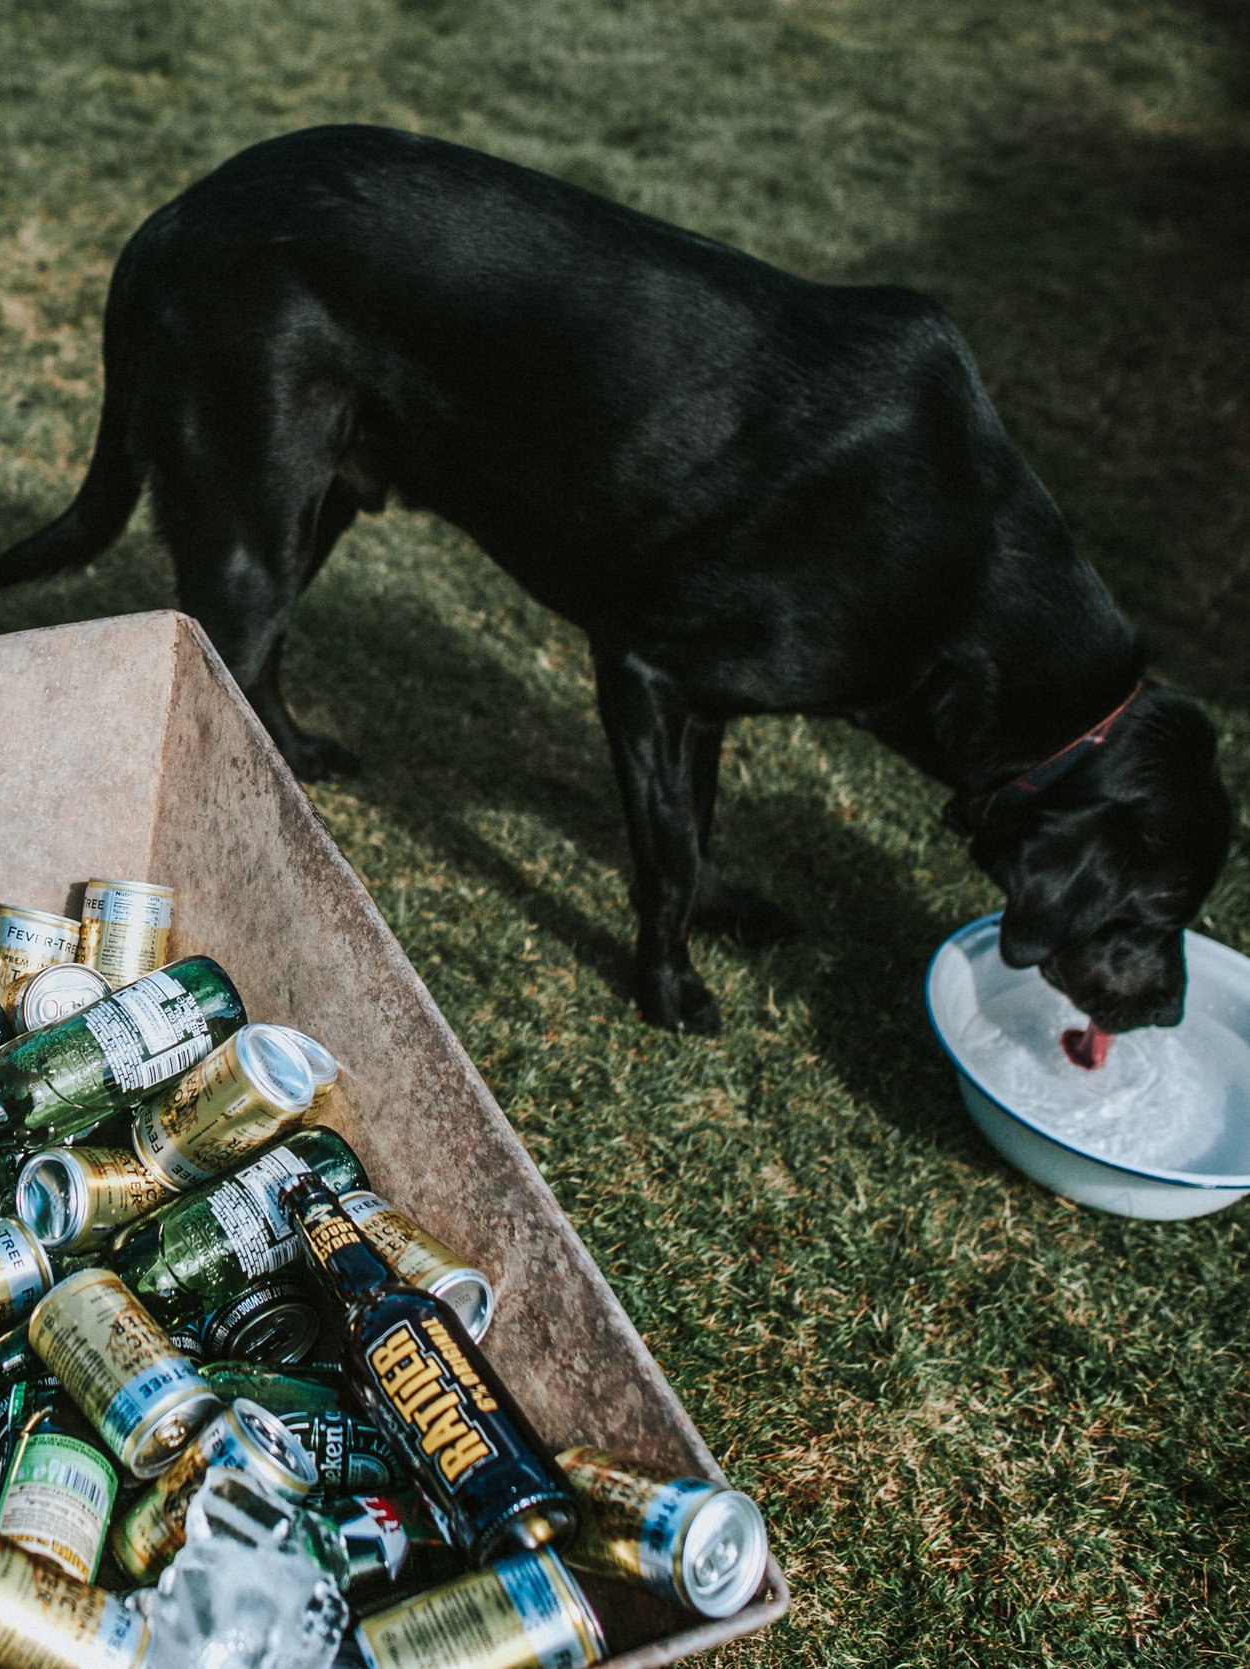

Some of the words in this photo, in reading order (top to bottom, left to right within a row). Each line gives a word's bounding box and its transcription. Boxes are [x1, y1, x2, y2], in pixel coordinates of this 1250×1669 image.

[84, 897, 105, 910] REE
[120, 1157, 142, 1205] ATER
[347, 1200, 383, 1214] REE
[421, 1317, 481, 1390] ORIGINAL
[371, 1328, 493, 1483] RATTLER
[468, 1385, 498, 1413] 6%
